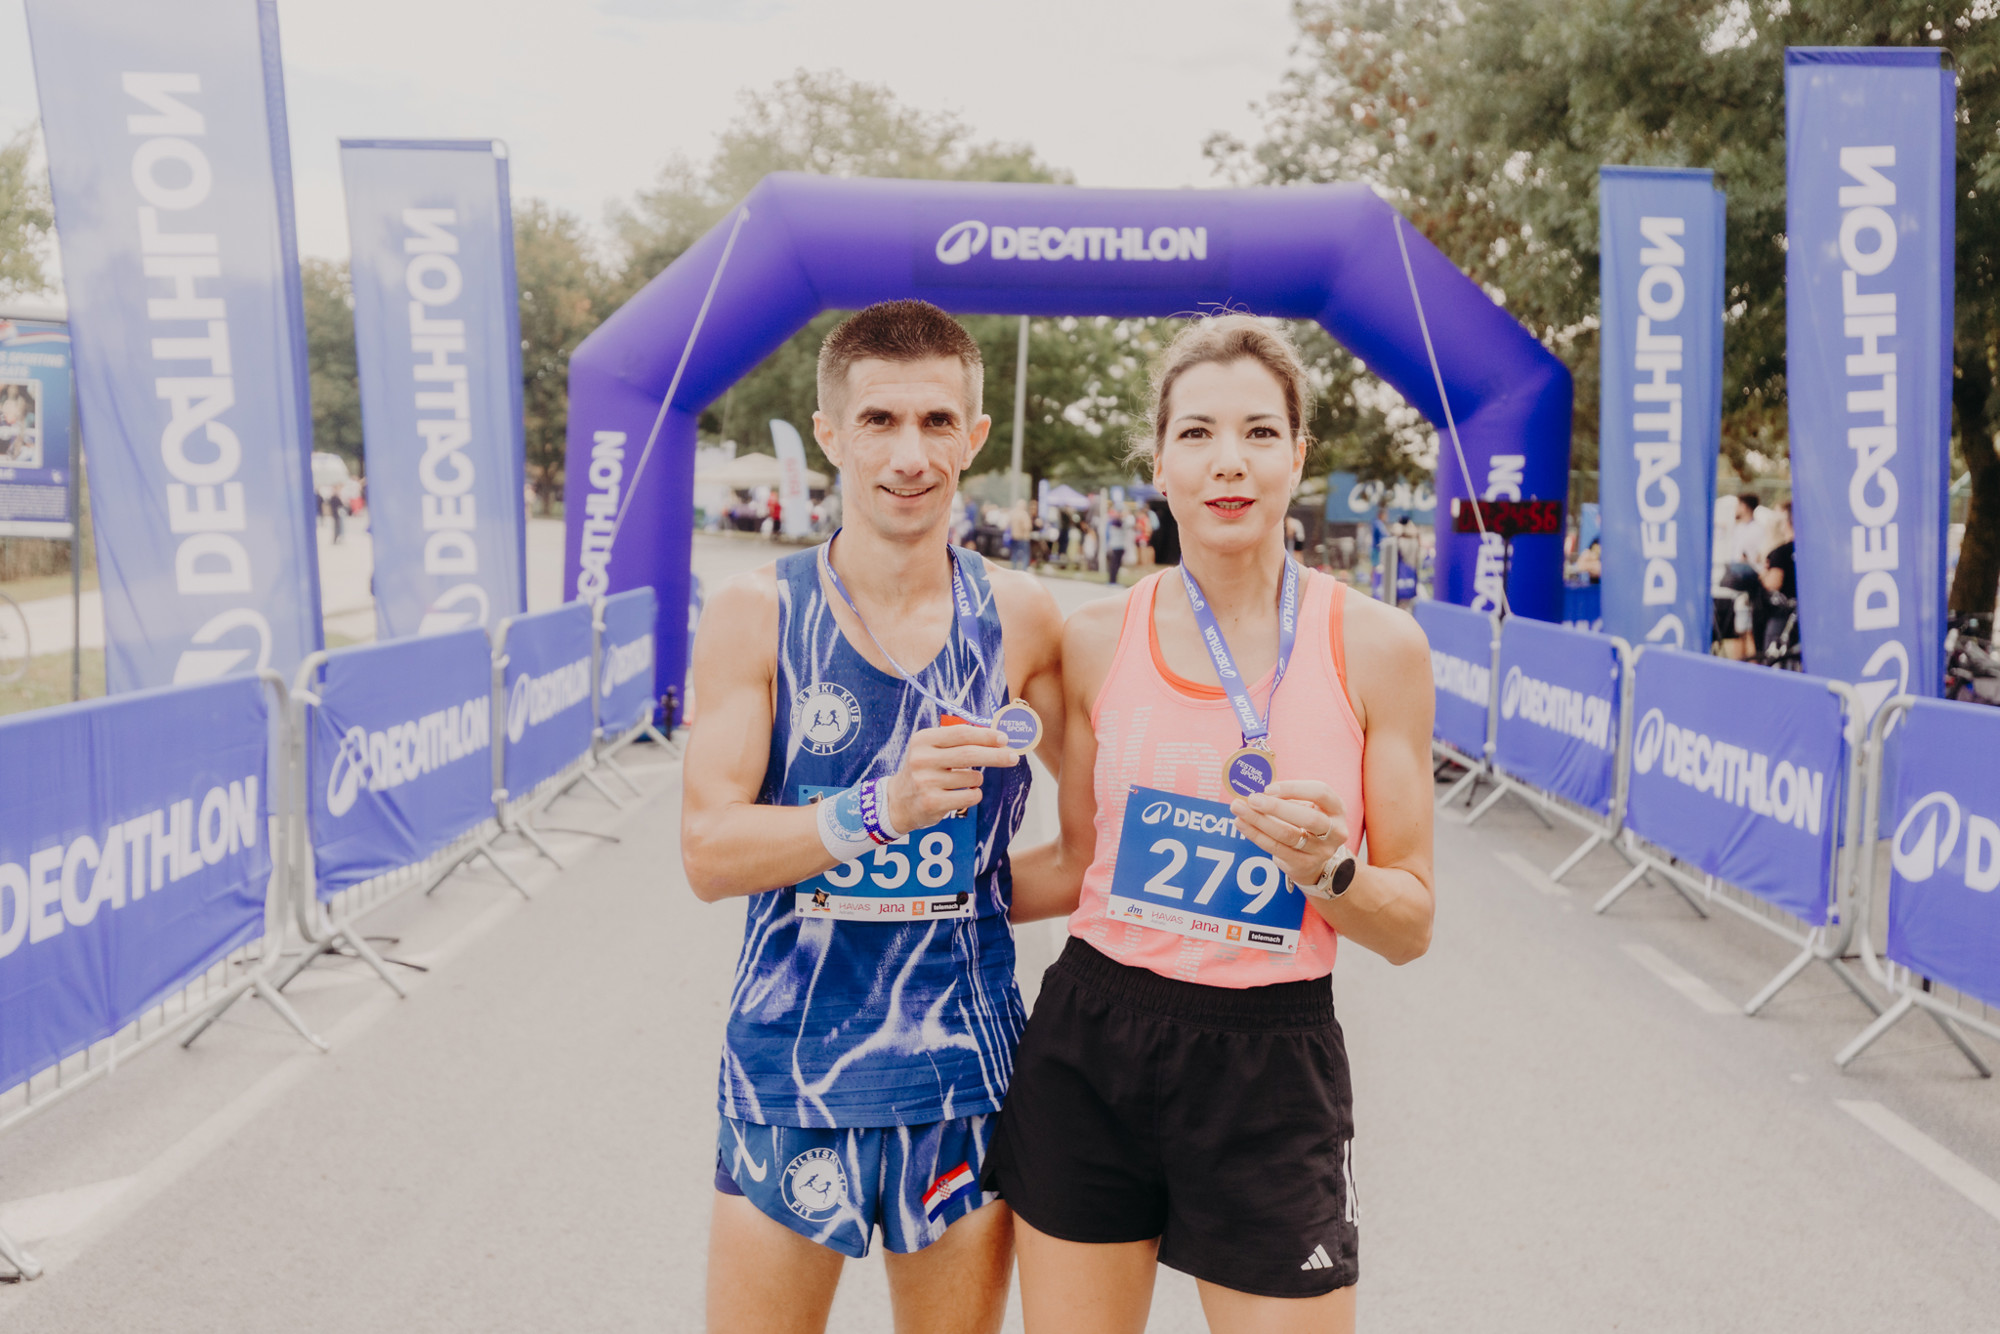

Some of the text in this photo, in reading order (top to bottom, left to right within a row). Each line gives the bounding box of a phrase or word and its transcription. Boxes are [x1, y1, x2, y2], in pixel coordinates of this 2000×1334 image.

[991, 226, 1207, 261] DECATHLON
[578, 430, 627, 601] CATHLON
[1283, 573, 1297, 633] DECATHLON
[1204, 625, 1231, 669] DECATHLON
[841, 691, 859, 722] KLUB
[1519, 675, 1612, 749] DECATHLON
[368, 694, 487, 792] DECATHLON
[812, 743, 834, 753] FIT
[1240, 769, 1265, 786] SPORTA
[1662, 722, 1823, 835] DECATHLON
[1143, 838, 1280, 916] 279
[933, 903, 958, 911] telemach
[1127, 904, 1143, 915] dm
[1151, 911, 1184, 925] HAVAS
[1251, 933, 1281, 944] telemach
[791, 1200, 813, 1218] FIT
